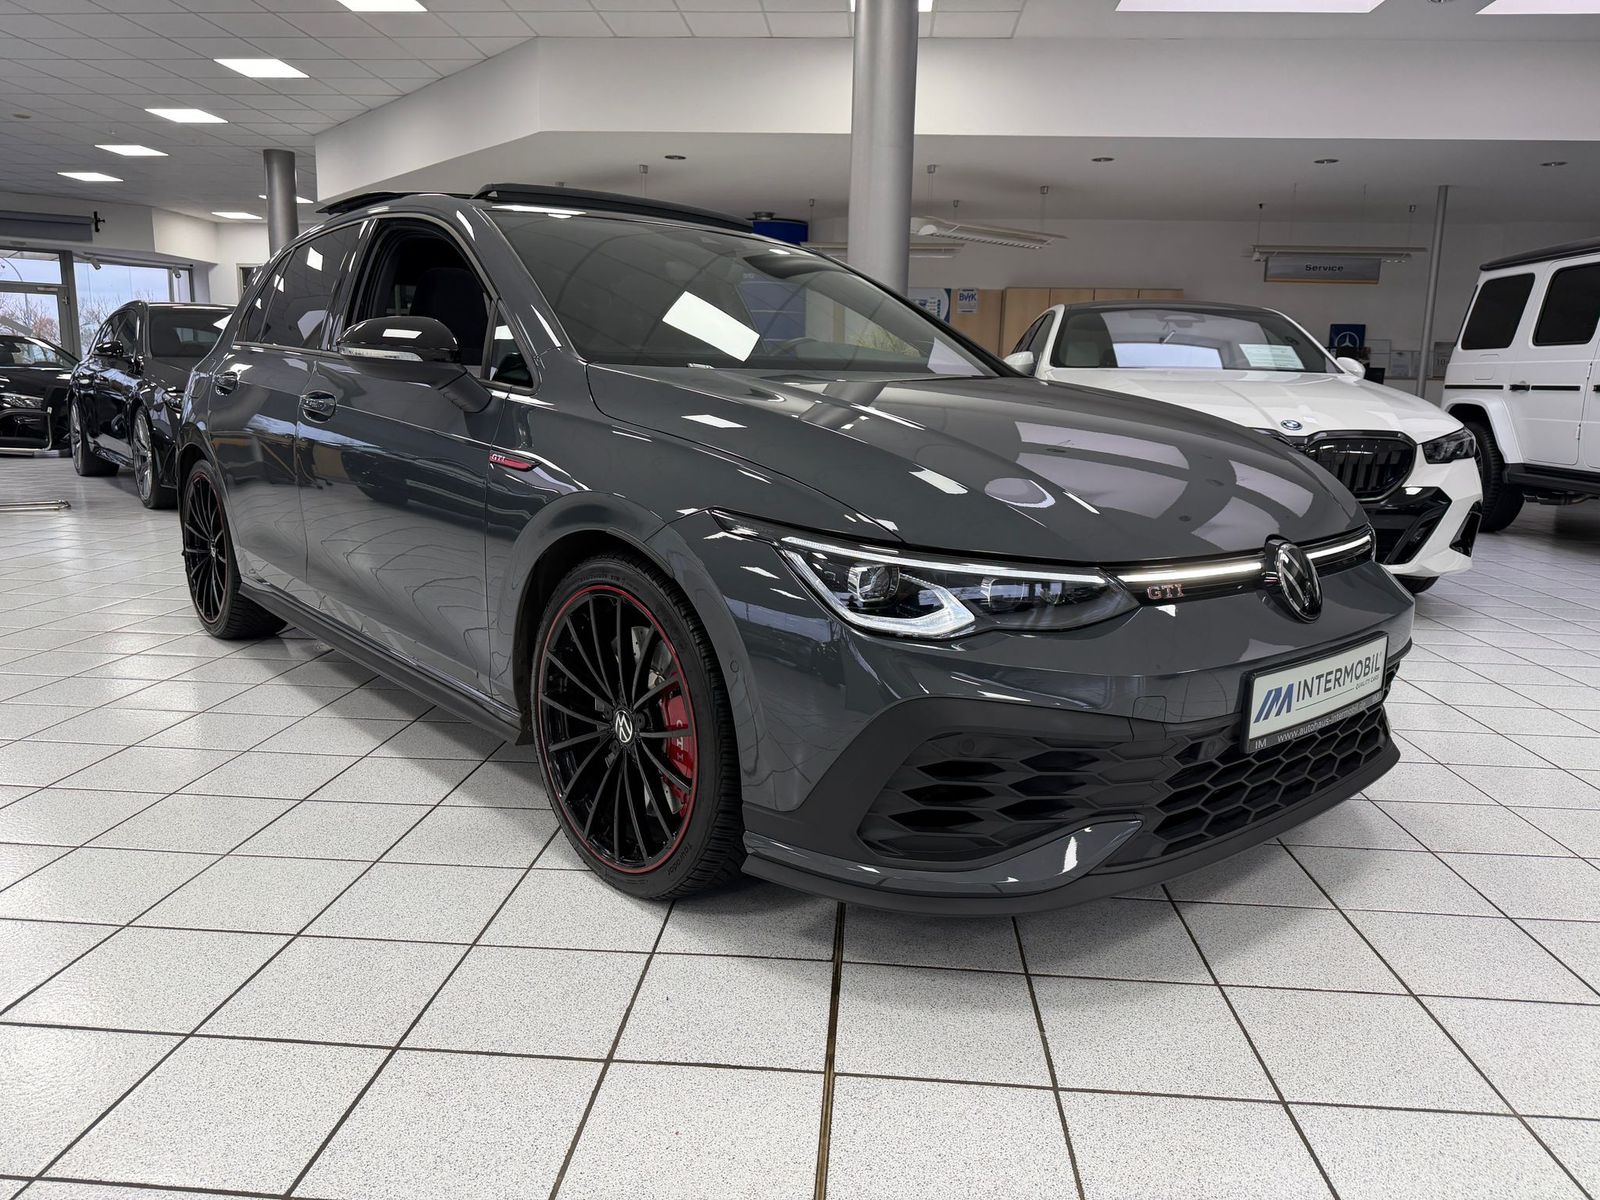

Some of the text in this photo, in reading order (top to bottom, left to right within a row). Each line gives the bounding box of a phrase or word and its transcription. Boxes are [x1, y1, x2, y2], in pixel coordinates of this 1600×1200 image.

[1305, 264, 1343, 272] Service
[491, 453, 506, 463] GTI
[1147, 583, 1184, 600] GTI
[1296, 651, 1381, 702] INTERMOBIL
